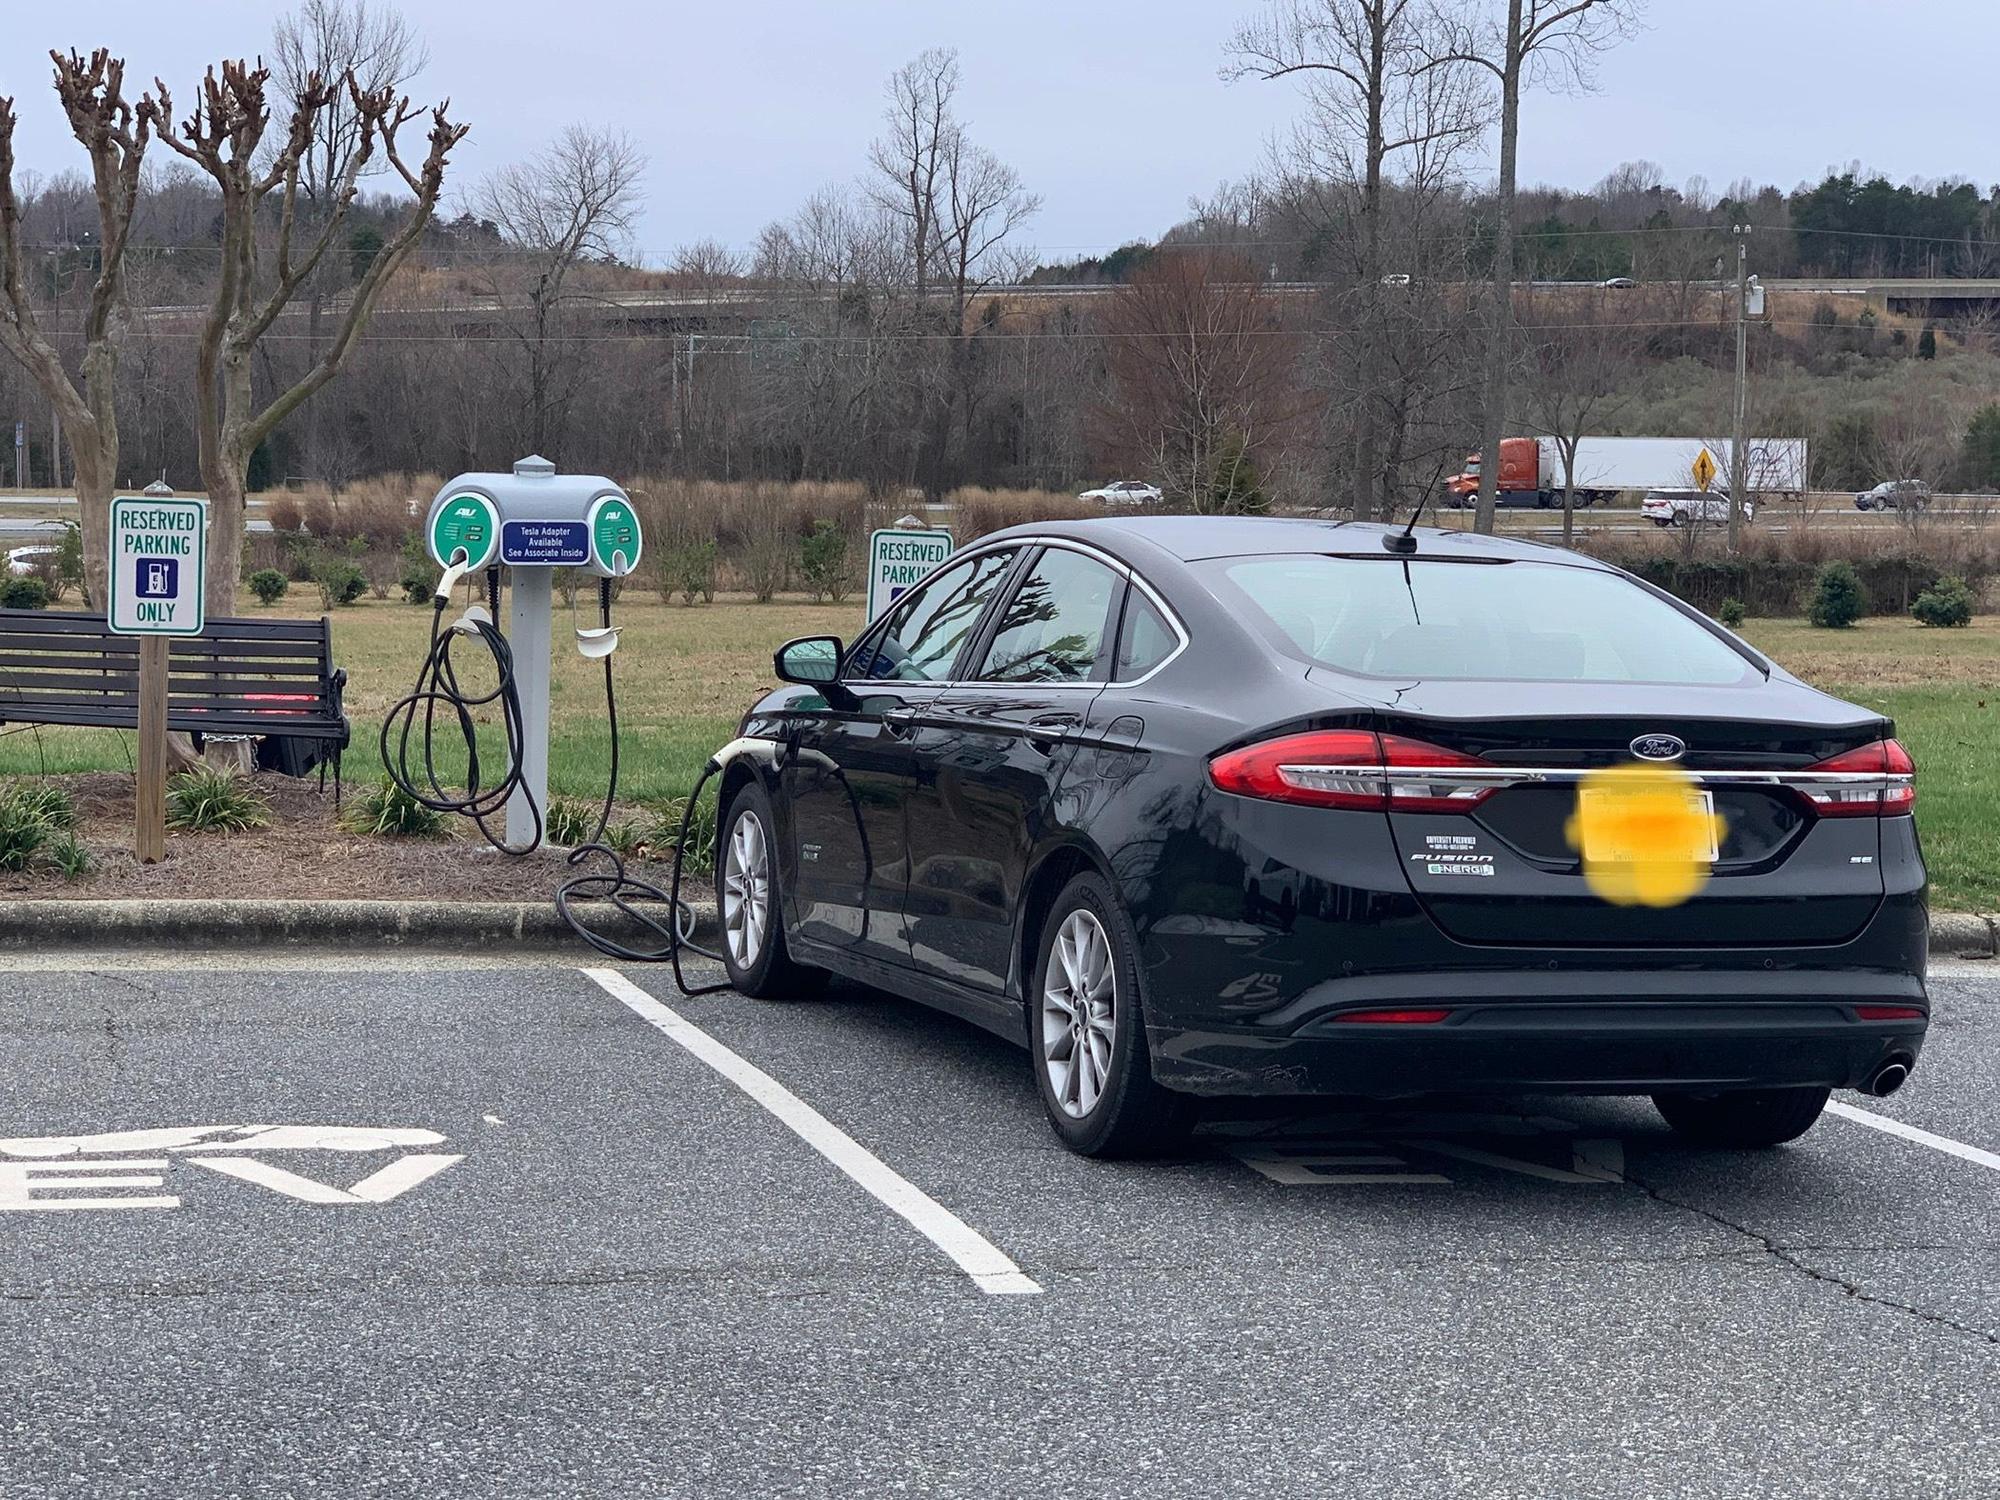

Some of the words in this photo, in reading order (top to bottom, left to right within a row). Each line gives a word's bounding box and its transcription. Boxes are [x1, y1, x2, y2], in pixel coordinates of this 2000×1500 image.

[120, 510, 195, 530] RESERVED
[521, 527, 539, 536] Tesla
[541, 527, 571, 537] Adapter
[124, 534, 190, 555] PARKING
[528, 537, 563, 547] Available
[508, 548, 522, 557] See
[524, 548, 559, 557] Associate
[561, 548, 584, 557] Inside
[879, 542, 944, 562] RESERVED
[882, 565, 930, 584] PARKI
[136, 602, 176, 622] ONLY
[1643, 739, 1674, 755] Ford
[1410, 853, 1494, 862] FUSION
[0, 1154, 467, 1211] EV
